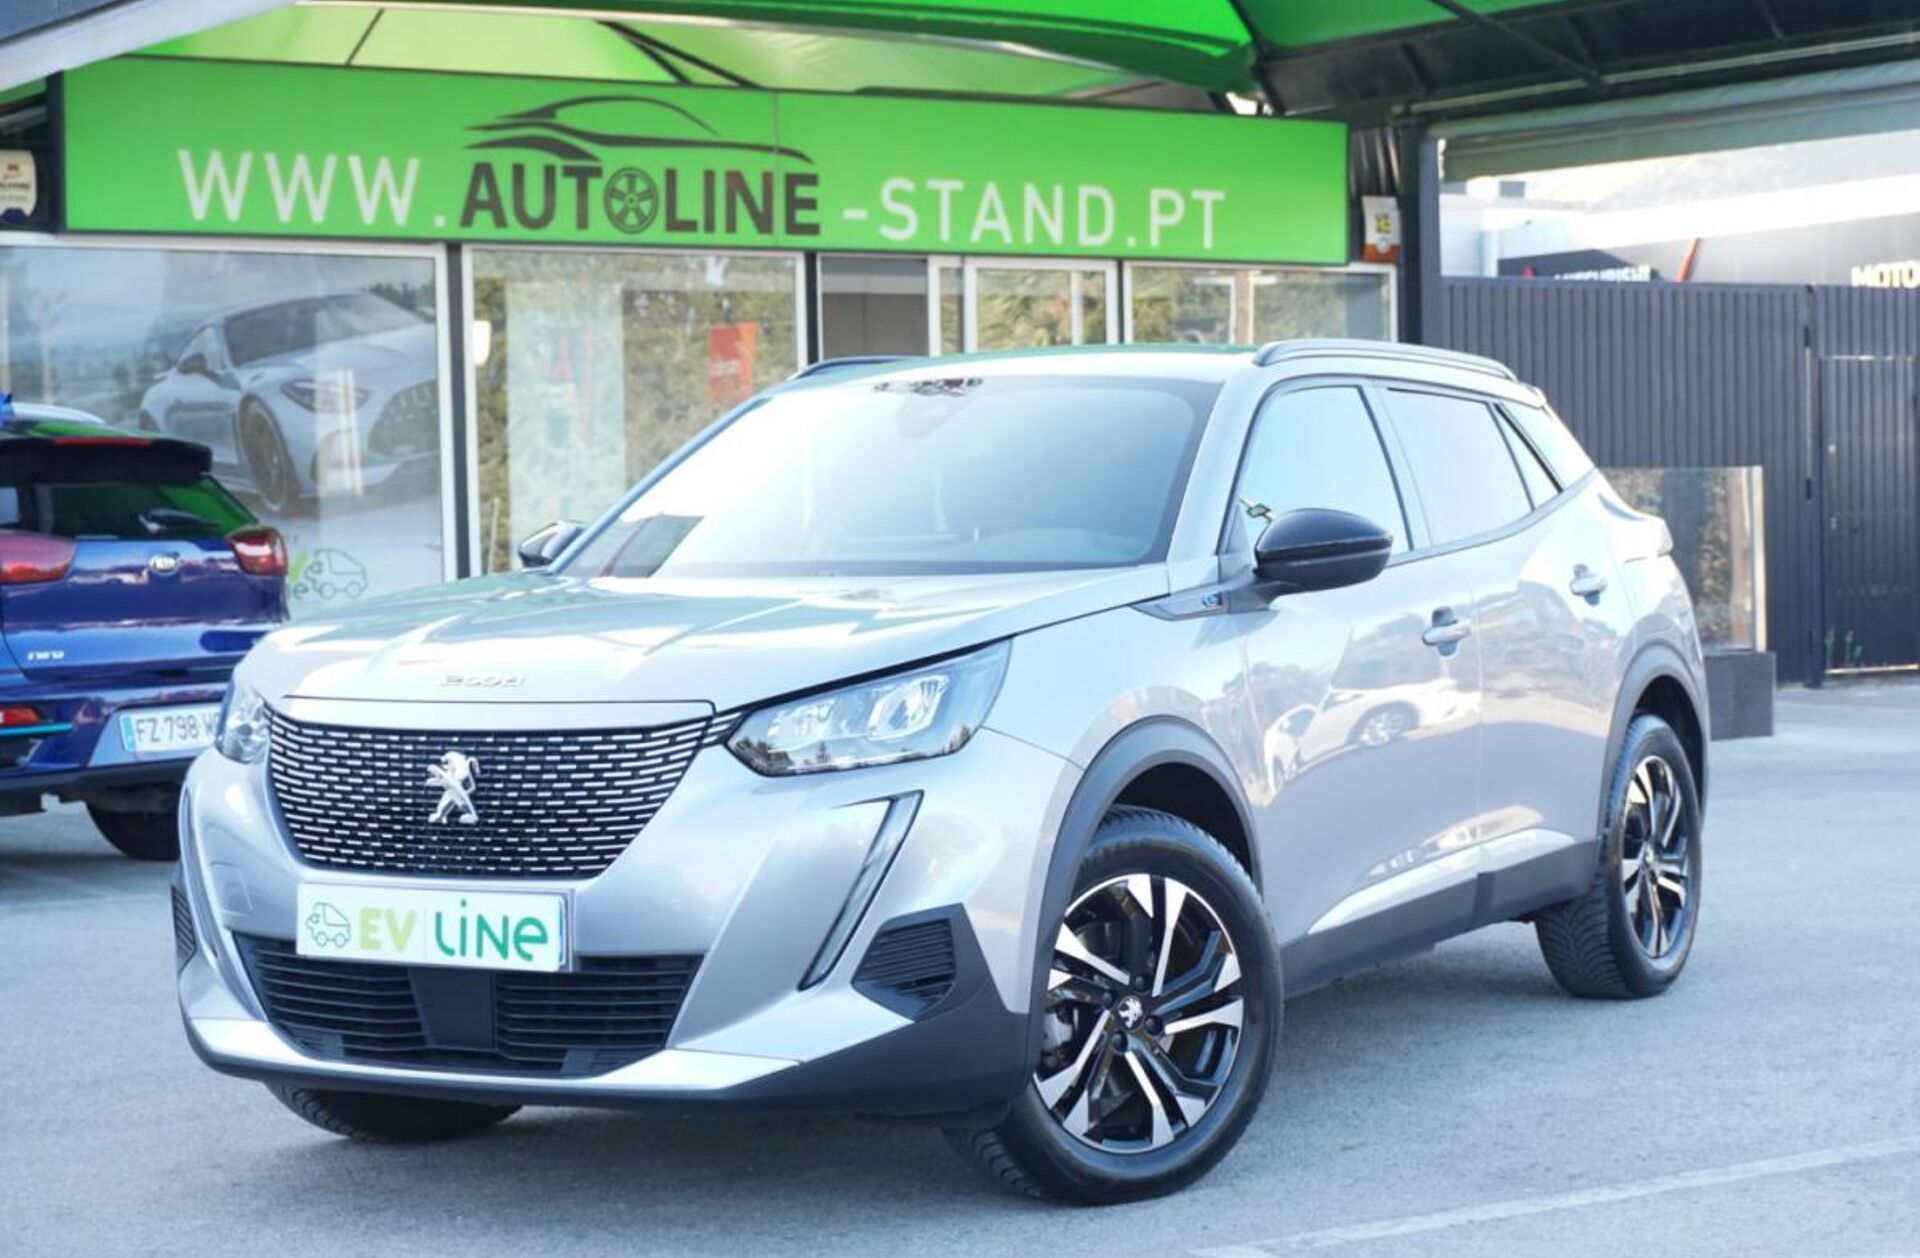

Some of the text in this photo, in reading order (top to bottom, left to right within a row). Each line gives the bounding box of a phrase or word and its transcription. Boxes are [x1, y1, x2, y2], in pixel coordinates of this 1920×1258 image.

[460, 161, 821, 236] AUTOLINE
[1554, 264, 1650, 283] UBISHI
[360, 907, 417, 953] EV
